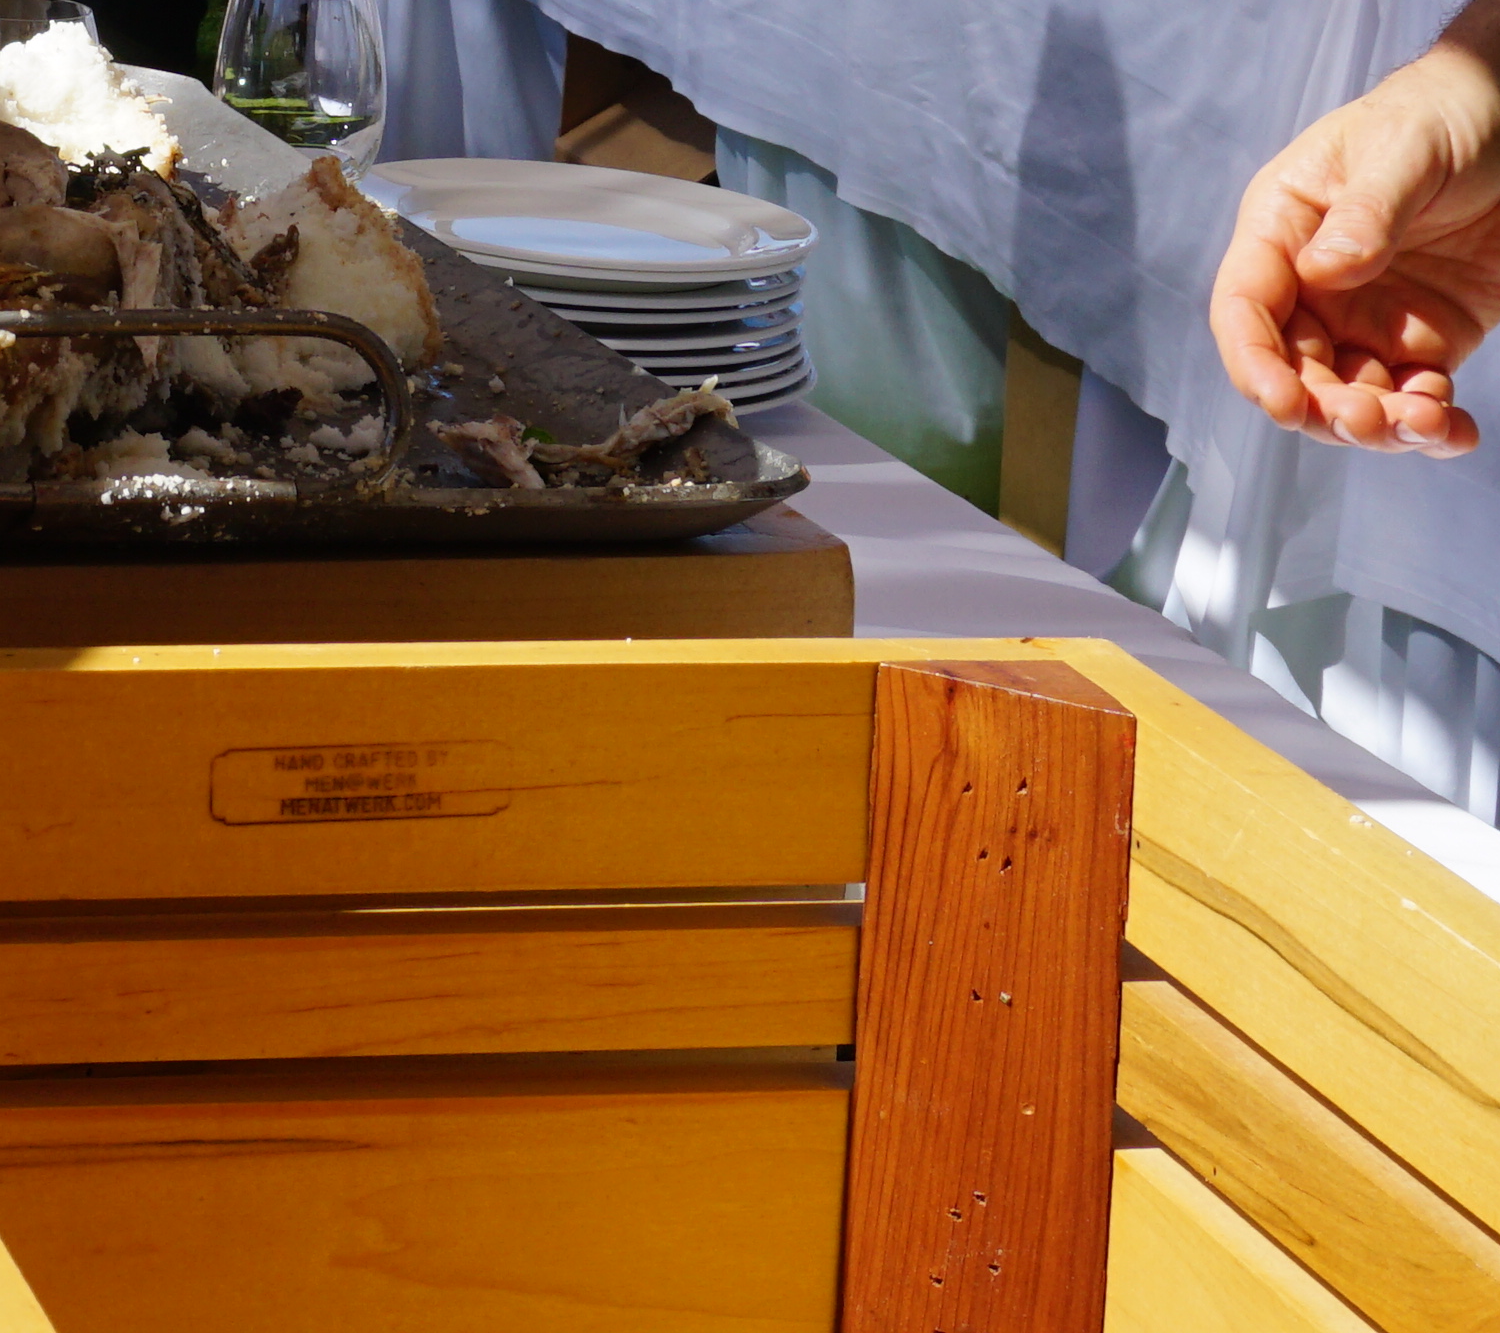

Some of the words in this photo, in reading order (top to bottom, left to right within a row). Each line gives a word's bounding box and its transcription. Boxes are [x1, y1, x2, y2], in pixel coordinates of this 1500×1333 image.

[274, 754, 325, 772] HAND
[333, 750, 419, 771] CRAFTED
[427, 749, 450, 767] BY
[304, 773, 418, 793] MEN@WERK
[279, 794, 443, 817] MENATWERK.COM
